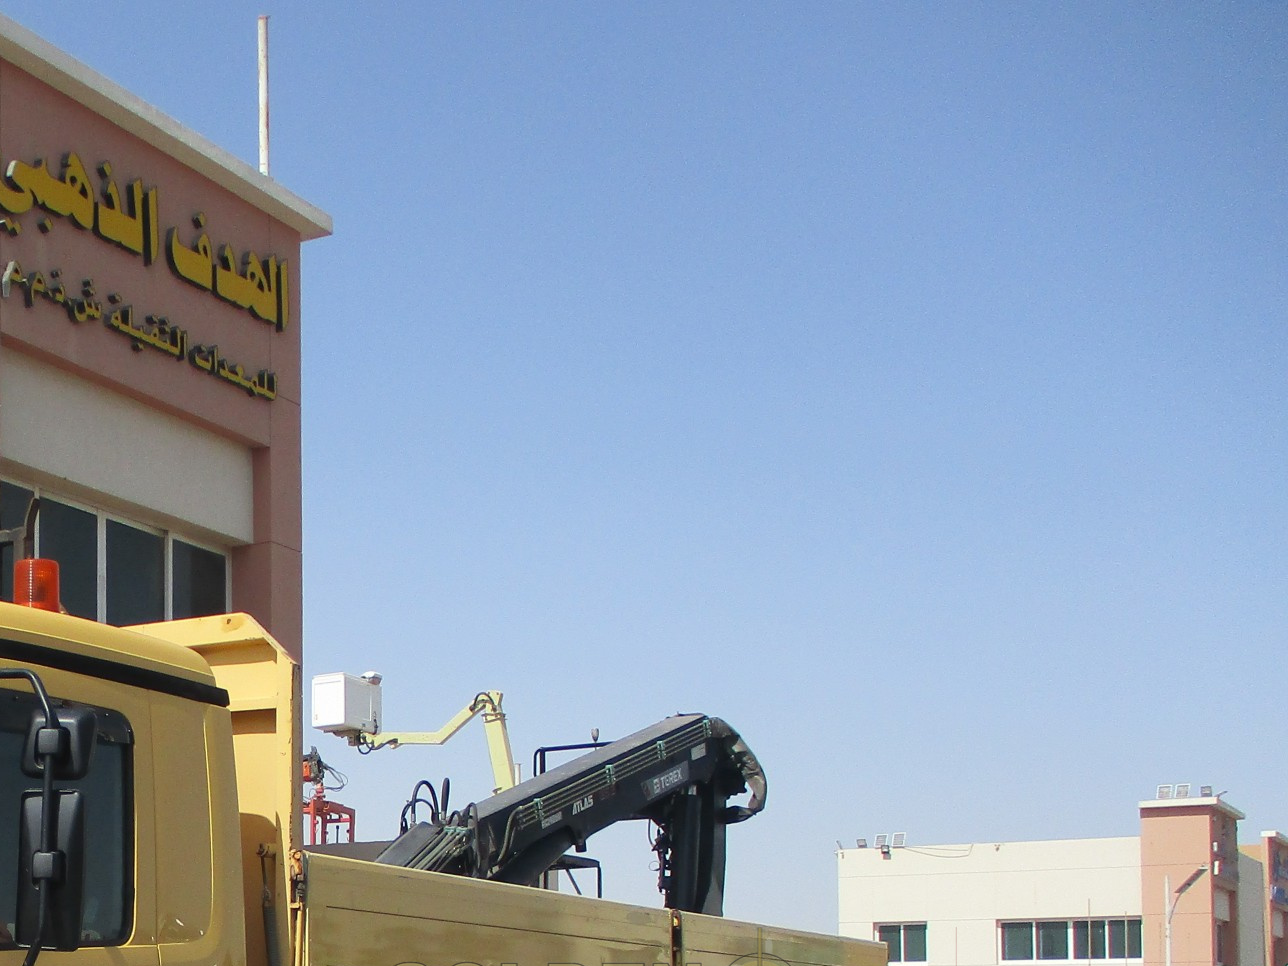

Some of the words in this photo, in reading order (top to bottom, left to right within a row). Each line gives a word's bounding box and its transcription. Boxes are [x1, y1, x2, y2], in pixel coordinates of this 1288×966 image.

[167, 211, 289, 333] الهدف
[660, 767, 683, 789] TEREX
[572, 794, 594, 816] ATLAS
